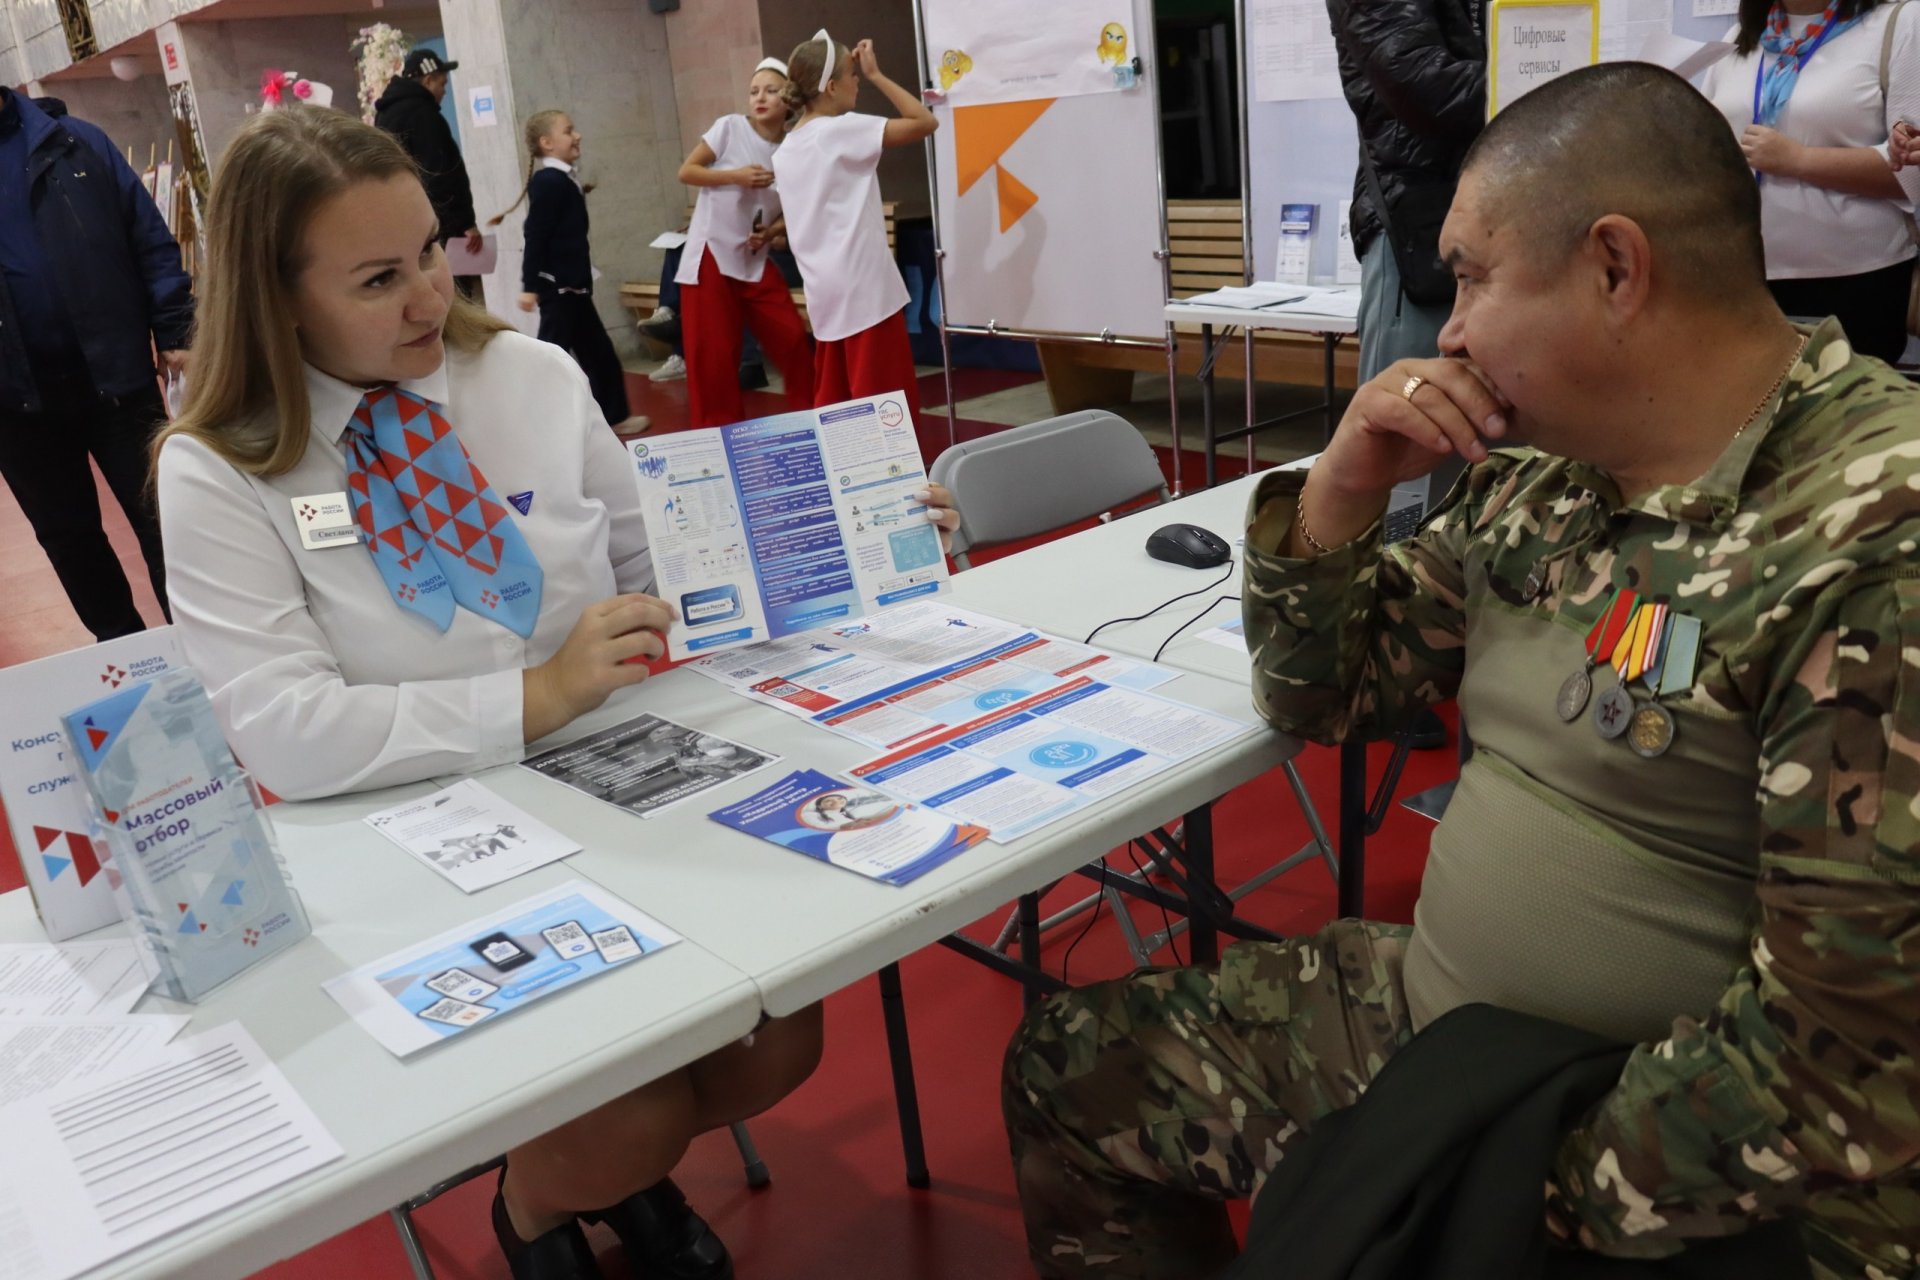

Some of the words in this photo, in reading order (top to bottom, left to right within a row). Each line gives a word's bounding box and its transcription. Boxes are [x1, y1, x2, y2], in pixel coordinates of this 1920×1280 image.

[1513, 25, 1566, 48] Цифровые
[1518, 60, 1560, 79] сервисы
[318, 530, 354, 538] Светлана
[416, 574, 443, 588] РАБОТА
[420, 580, 447, 595] РОССИИ
[500, 580, 527, 595] РАБОТА
[503, 587, 532, 602] РОССИИ
[128, 656, 165, 670] РАБОТА
[131, 662, 168, 678] РОССИИ
[27, 774, 74, 795] служ
[124, 776, 224, 832] Массовый
[135, 818, 190, 853] отбор
